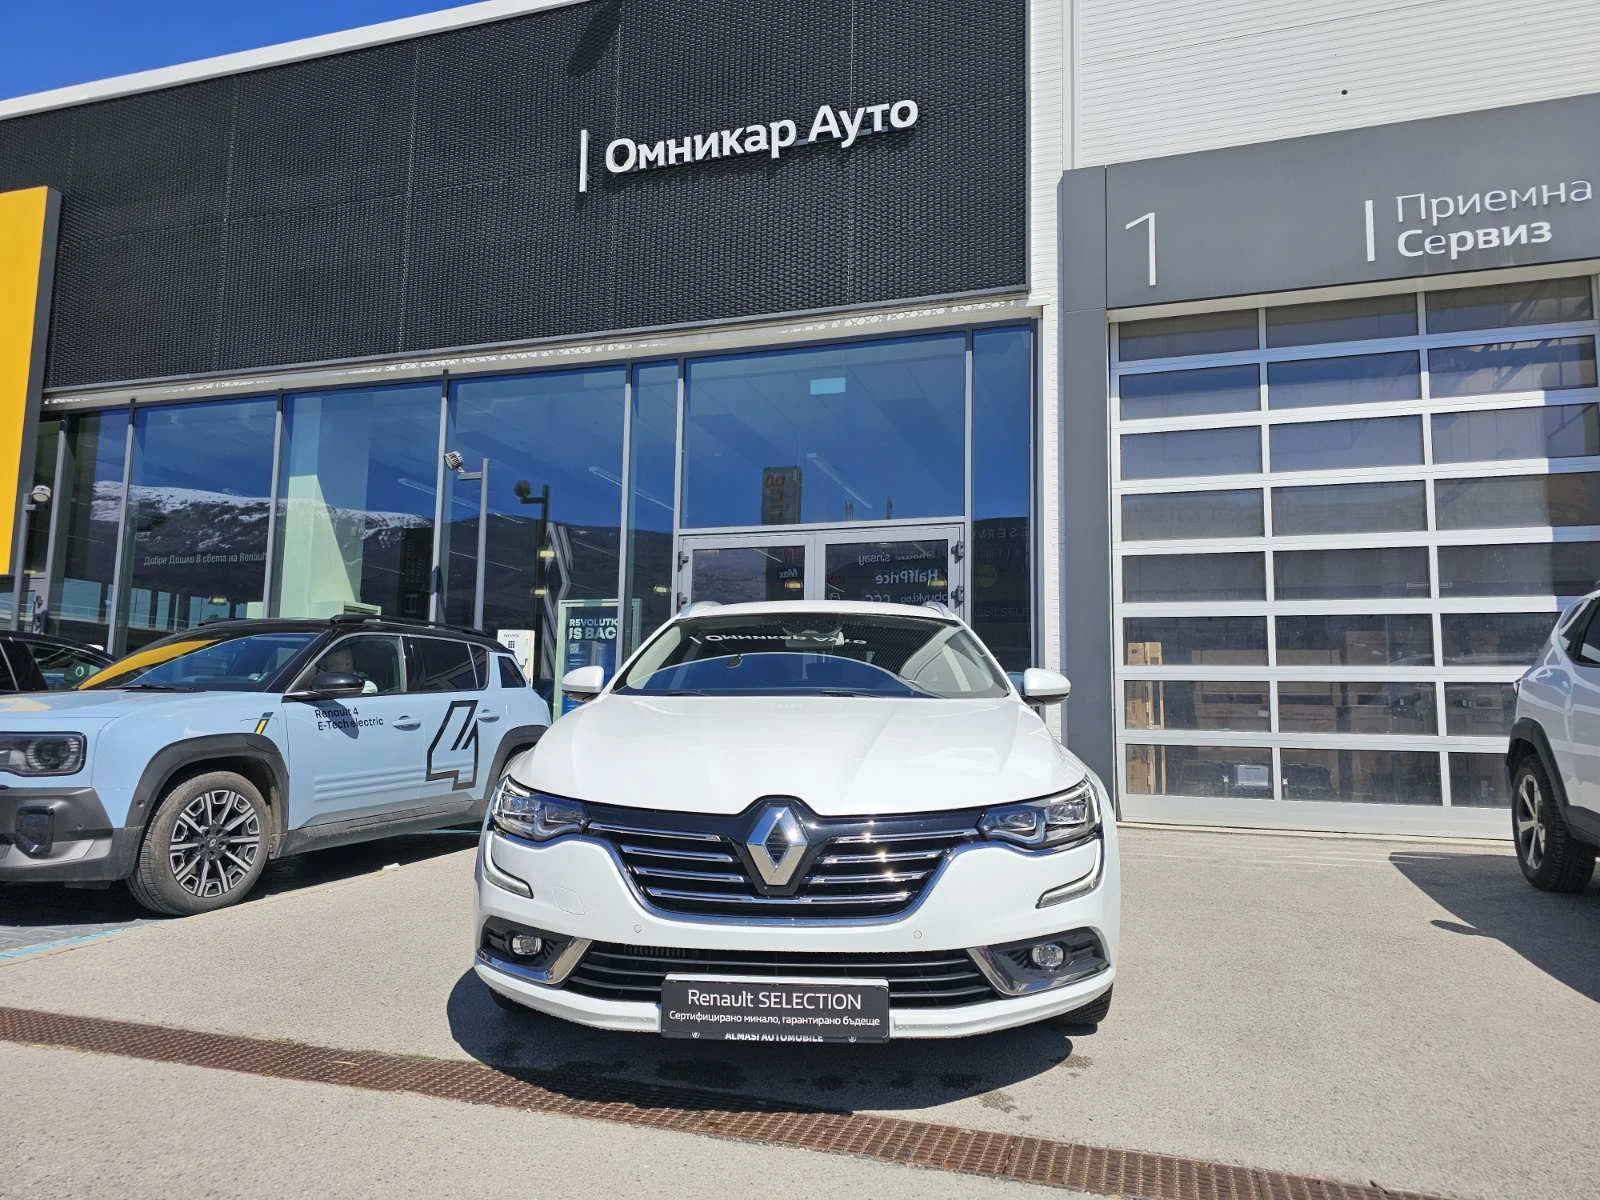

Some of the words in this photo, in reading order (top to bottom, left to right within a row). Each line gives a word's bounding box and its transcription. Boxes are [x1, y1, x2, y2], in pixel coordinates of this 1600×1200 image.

[605, 119, 797, 174] Омникар
[808, 99, 919, 148] Ауто
[1396, 179, 1593, 226] Приемна
[1125, 211, 1157, 286] 1
[1397, 220, 1553, 260] Сервиз
[569, 617, 618, 627] R5VOLUTIO
[568, 627, 583, 640] IS
[584, 626, 618, 640] BAC
[315, 708, 351, 719] Renault
[353, 707, 359, 716] 4
[318, 718, 350, 731] E-Tech
[350, 716, 384, 728] electric
[688, 989, 753, 1007] Renault
[758, 992, 862, 1010] SELECTION
[669, 1010, 742, 1024] Сертифицирано
[743, 1013, 781, 1025] минало,
[782, 1015, 841, 1027] гарантирано
[843, 1016, 881, 1028] бъдеще
